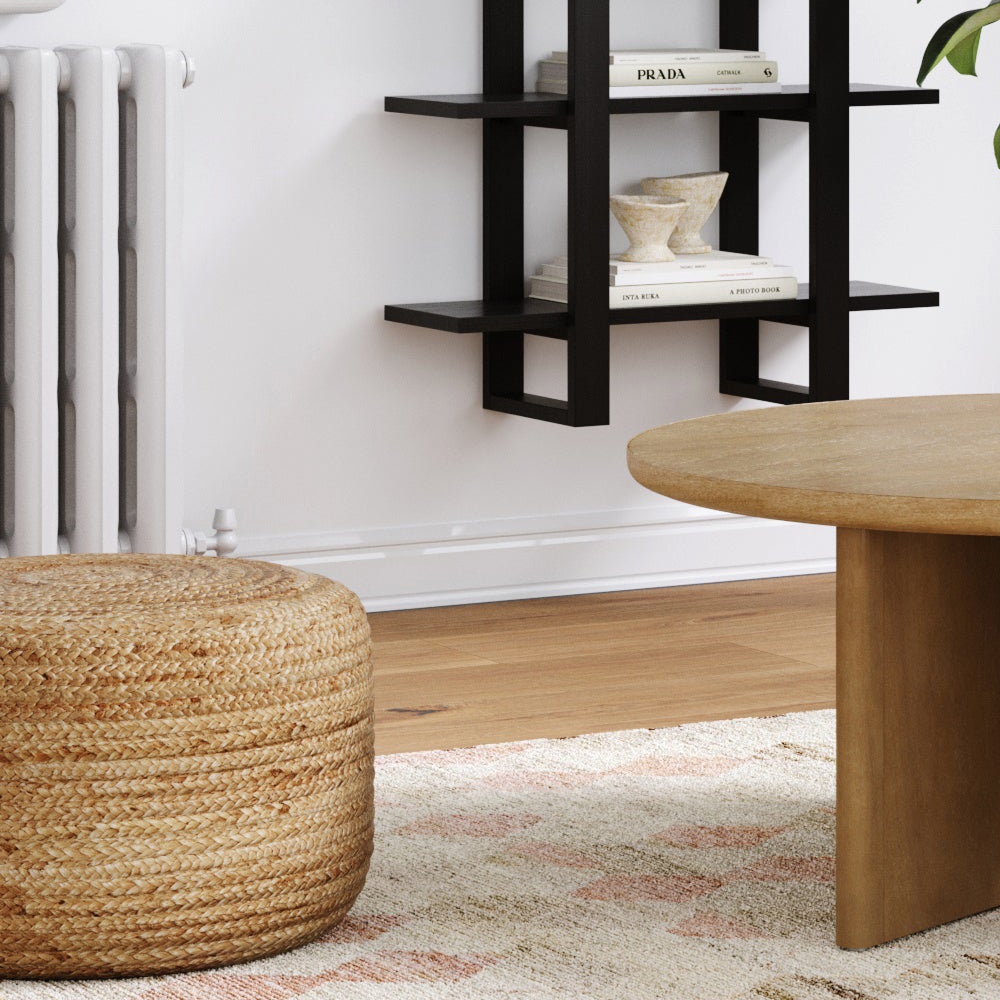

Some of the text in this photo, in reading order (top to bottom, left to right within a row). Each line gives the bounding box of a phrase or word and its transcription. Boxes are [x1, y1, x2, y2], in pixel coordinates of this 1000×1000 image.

[637, 68, 686, 80] PRADA
[736, 287, 760, 295] PHOTO
[761, 286, 781, 294] BOOK
